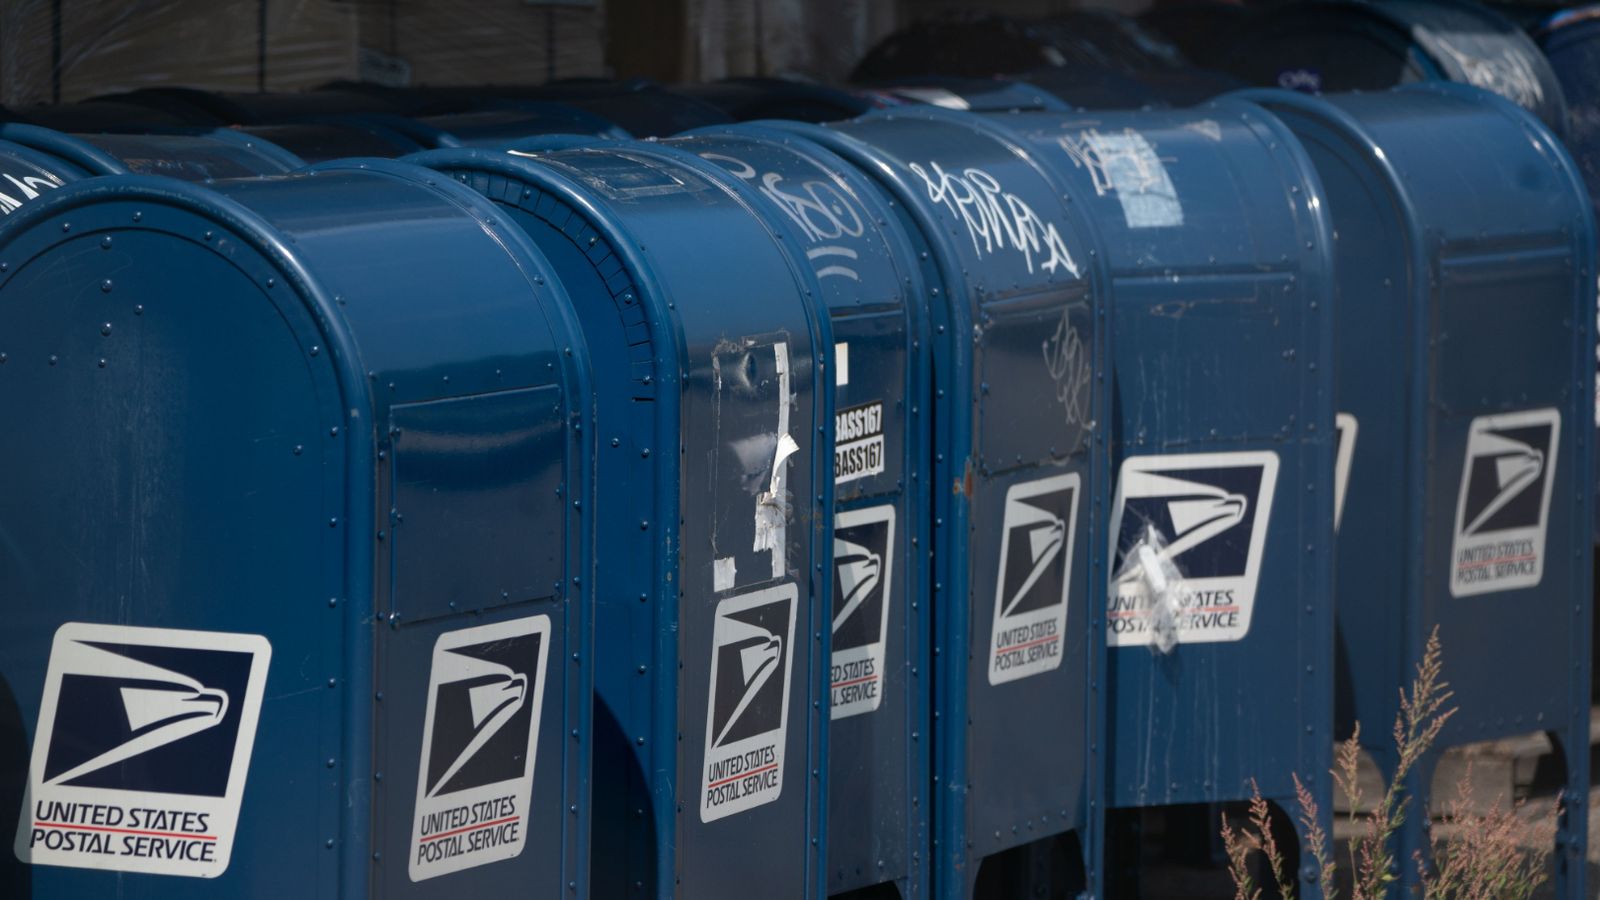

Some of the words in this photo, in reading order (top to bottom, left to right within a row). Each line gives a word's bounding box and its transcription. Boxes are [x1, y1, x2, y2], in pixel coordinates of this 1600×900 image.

[836, 441, 881, 477] BASS167
[996, 625, 1030, 649] UNITED
[1030, 617, 1058, 641] STATES
[842, 657, 875, 681] STATES
[994, 649, 1026, 672] POSTAL
[1027, 640, 1059, 665] SERVICE
[840, 680, 877, 705] SERVICE
[708, 754, 744, 782] UNITED
[744, 744, 776, 771] STATES
[706, 781, 741, 808] POSTAL
[742, 769, 778, 797] SERVICE
[36, 800, 124, 826] UNITED
[127, 808, 210, 833] STATES
[421, 806, 470, 836] UNITED
[470, 795, 516, 824] STATES
[30, 828, 115, 855] POSTAL
[417, 834, 465, 865] POSTAL
